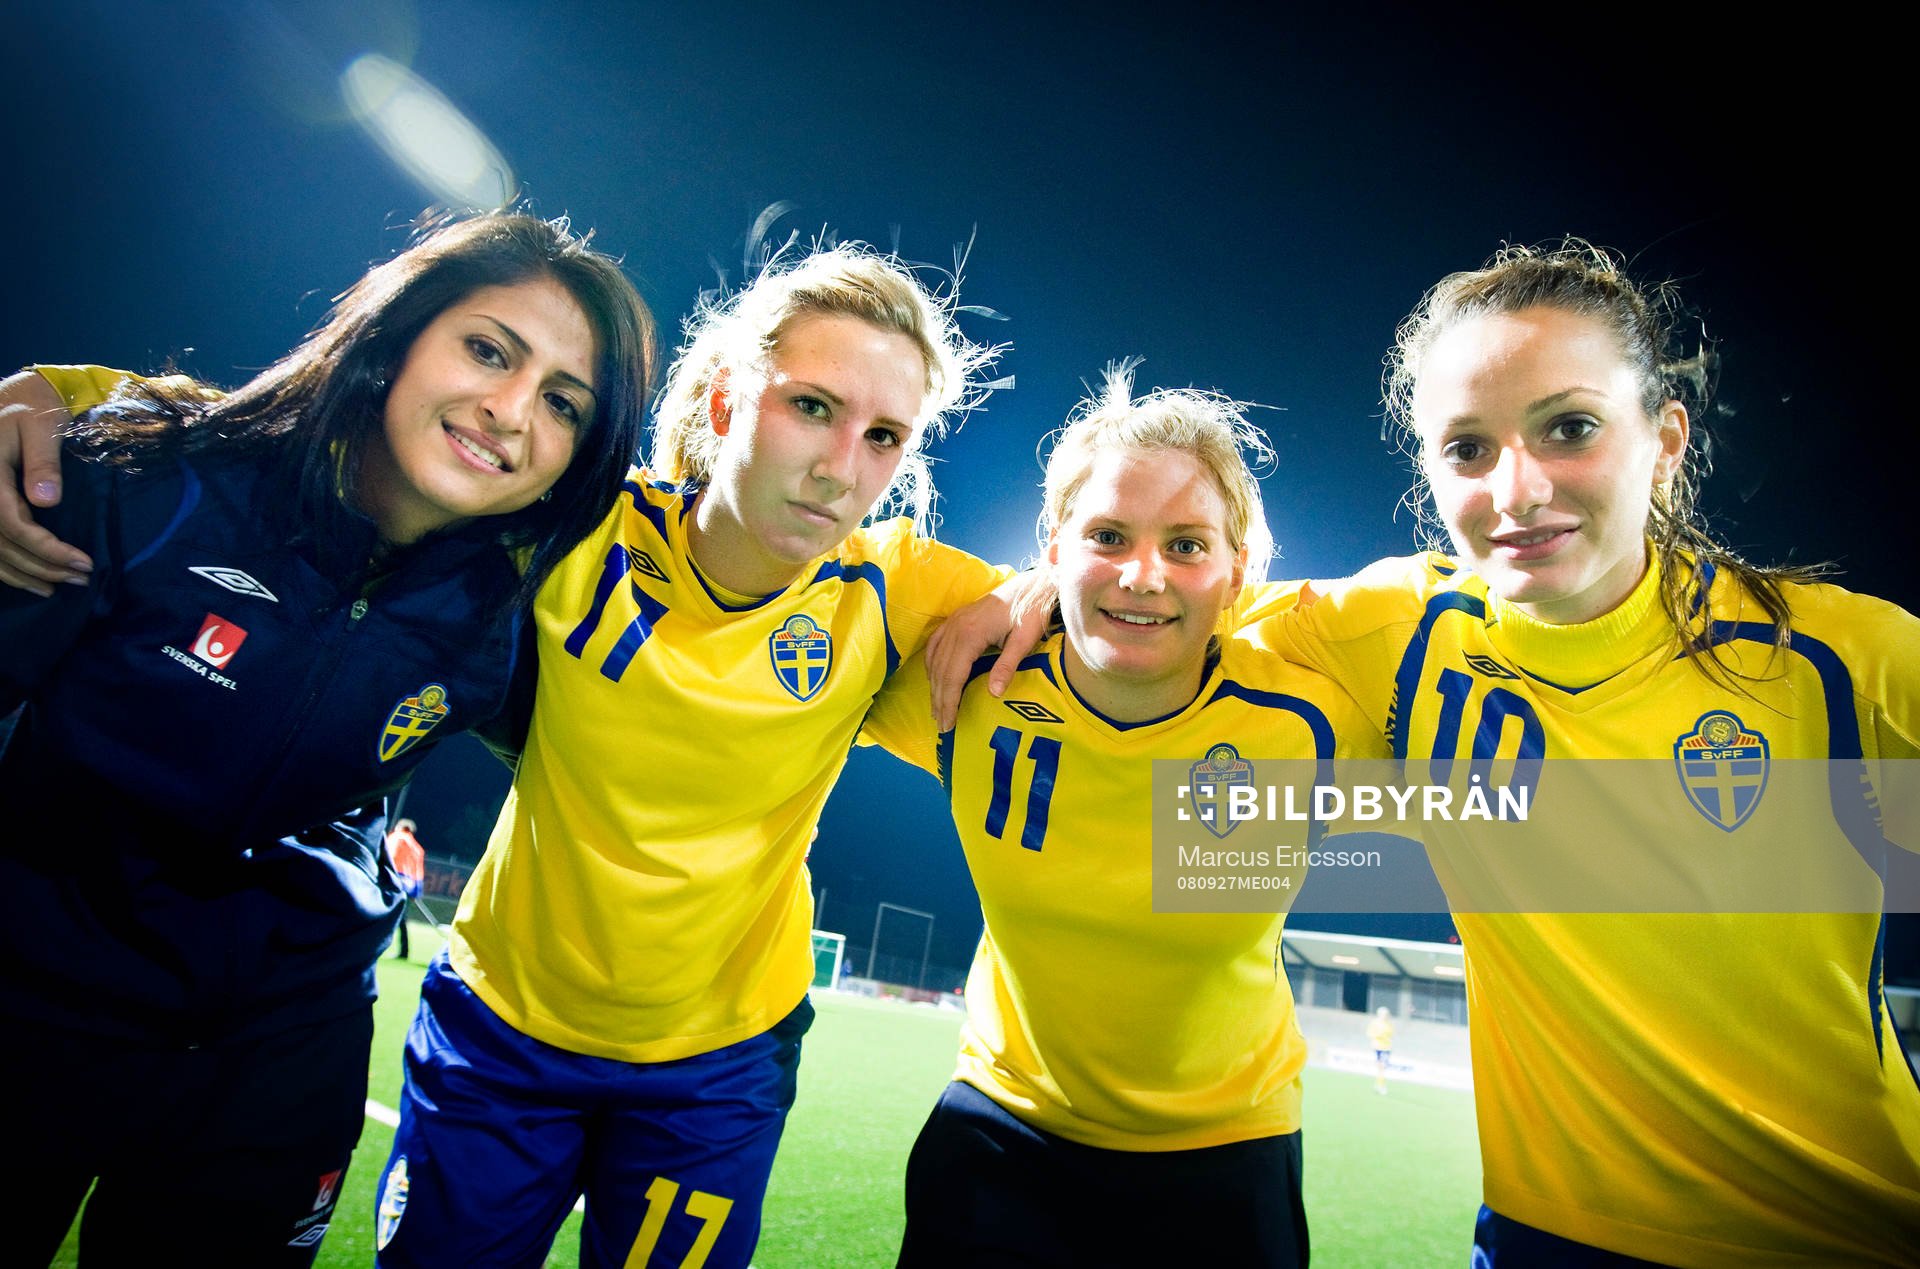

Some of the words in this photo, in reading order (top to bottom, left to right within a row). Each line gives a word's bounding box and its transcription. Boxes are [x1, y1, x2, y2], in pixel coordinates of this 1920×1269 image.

[564, 542, 670, 682] 17
[161, 645, 208, 676] SVENSKA
[208, 671, 237, 690] SPEL
[985, 726, 1062, 852] 11
[1207, 773, 1237, 781] SvFF
[1429, 667, 1546, 823] 10
[1701, 750, 1744, 760] SvFF
[623, 1176, 734, 1269] 17
